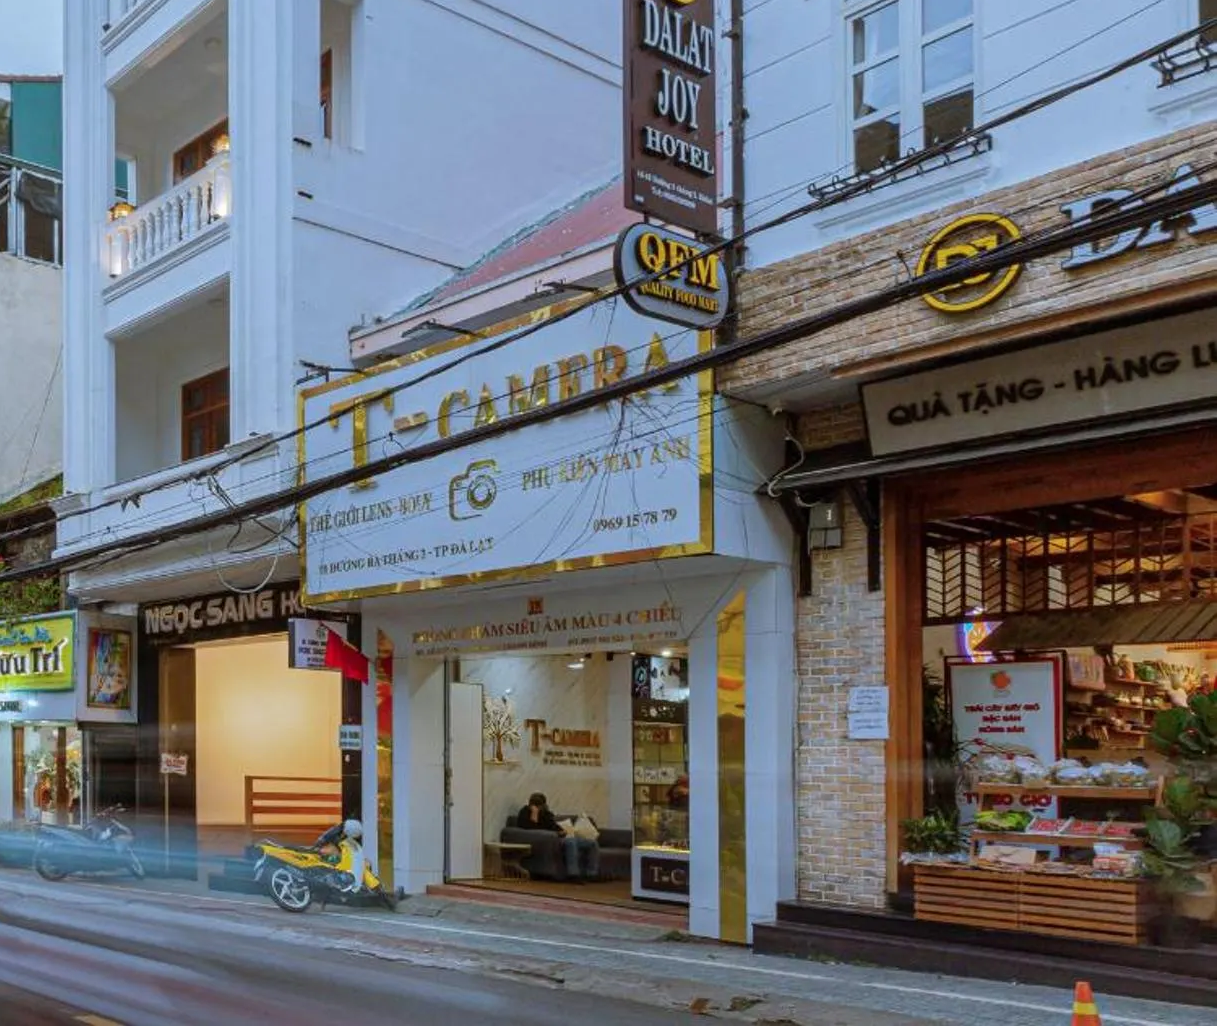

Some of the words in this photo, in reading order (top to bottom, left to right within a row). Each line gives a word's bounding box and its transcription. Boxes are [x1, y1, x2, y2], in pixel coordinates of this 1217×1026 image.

[657, 68, 701, 129] JOY
[645, 126, 715, 174] HOTEL
[639, 232, 720, 290] QFM
[887, 390, 951, 426] QUÀ
[957, 377, 1045, 415] TẶNG
[1073, 350, 1180, 391] HÀNG
[593, 516, 623, 534] 0969
[626, 514, 640, 529] 15
[643, 511, 658, 525] 78
[662, 508, 677, 521] 79
[144, 601, 203, 634] NGỌC
[206, 590, 274, 624] SANG
